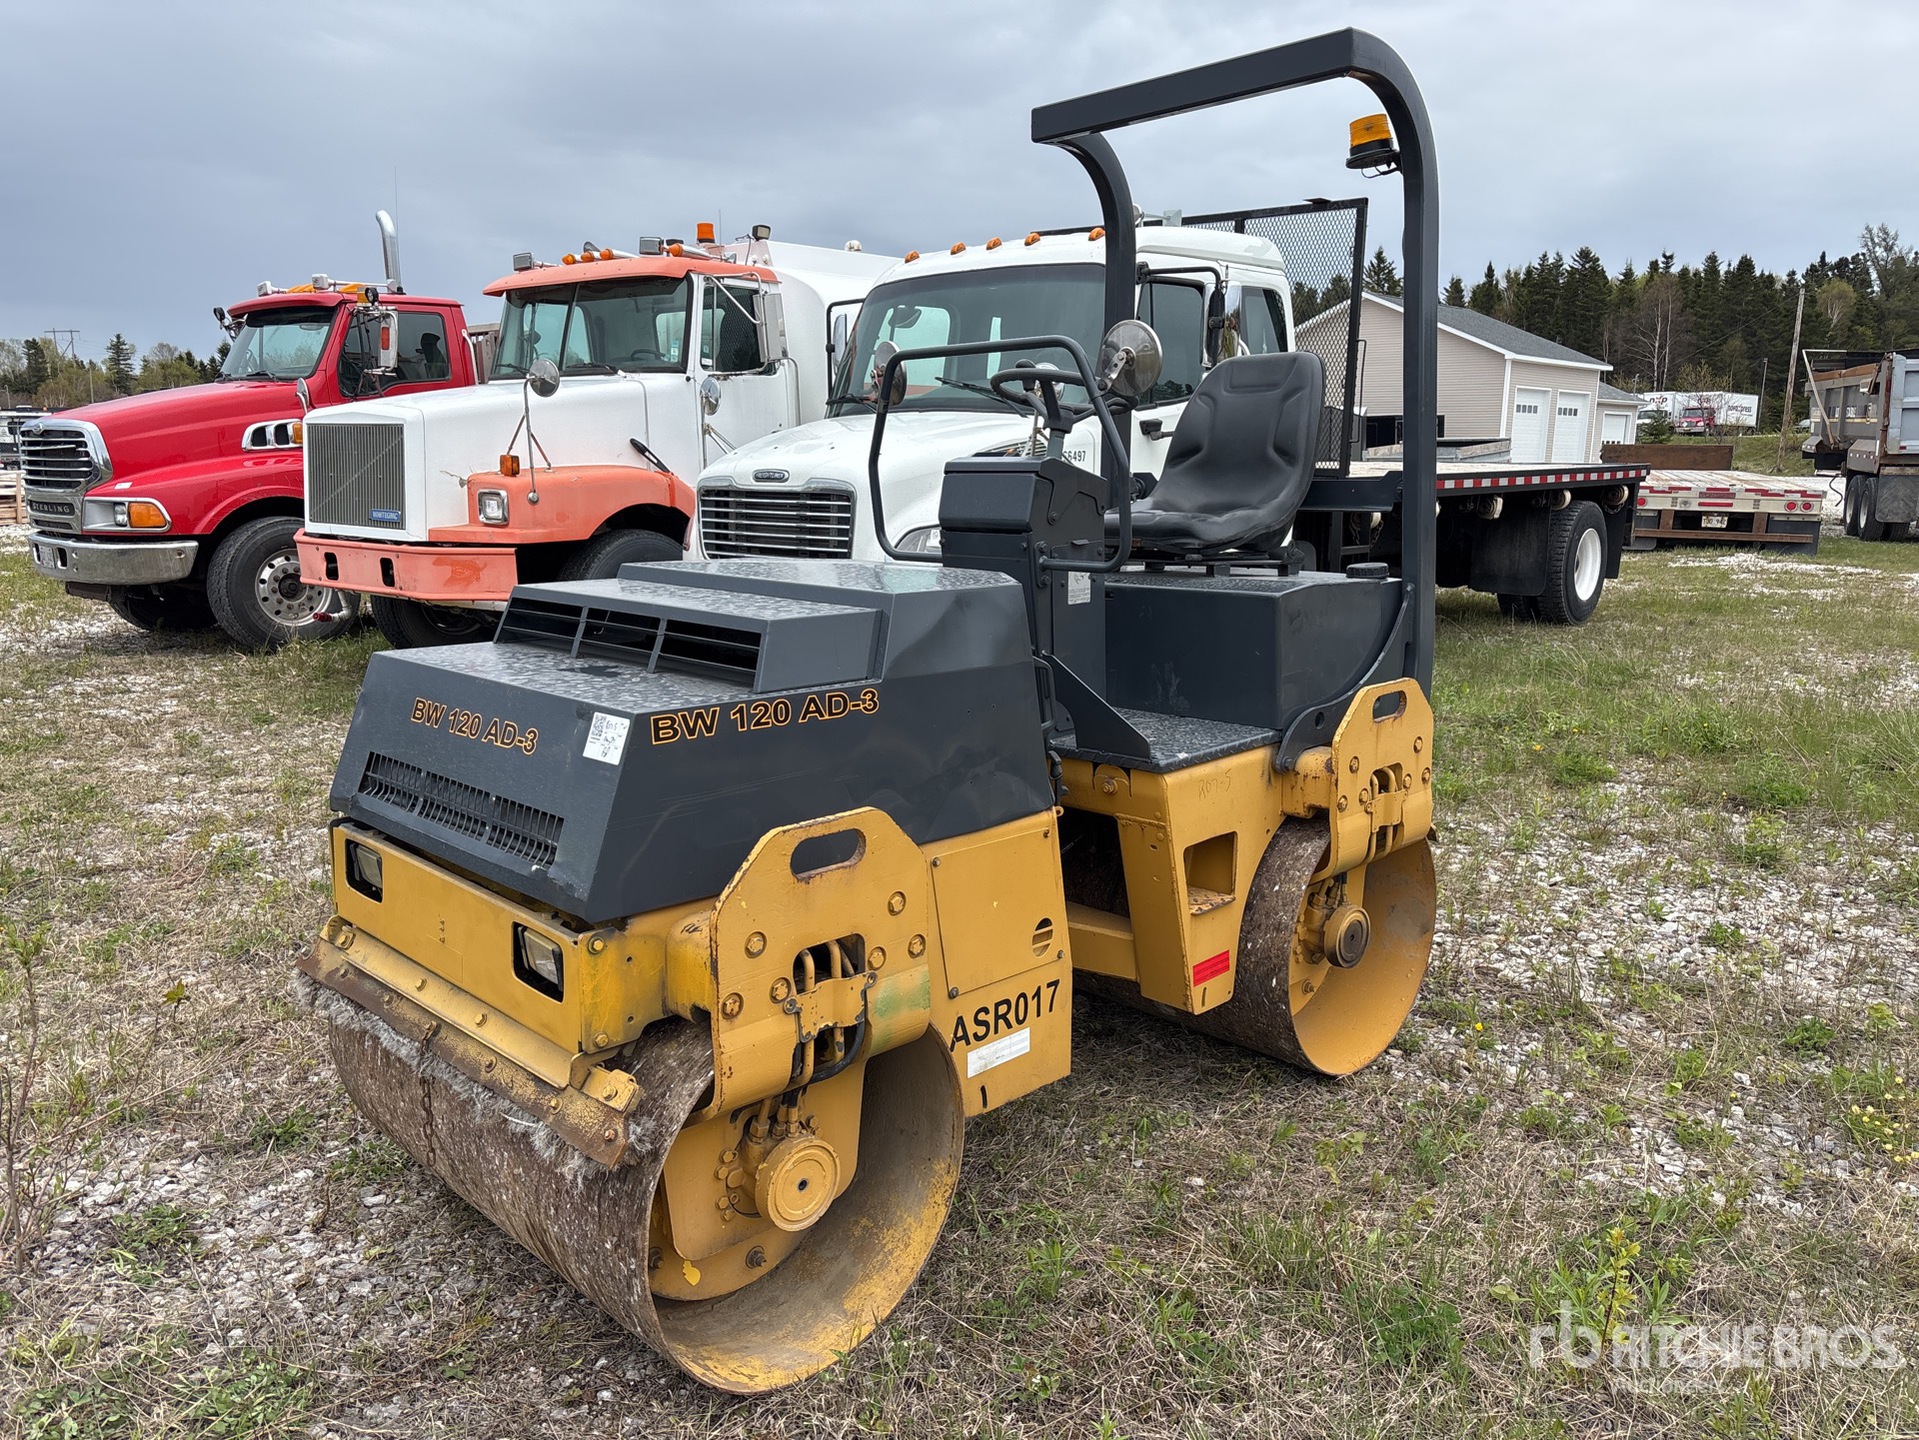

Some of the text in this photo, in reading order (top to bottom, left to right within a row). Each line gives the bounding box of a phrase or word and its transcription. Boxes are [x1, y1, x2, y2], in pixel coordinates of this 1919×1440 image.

[32, 503, 70, 513] STERLING
[410, 697, 539, 755] BW 120 AD-3
[650, 706, 720, 745] BW
[730, 698, 792, 732] 120
[798, 687, 879, 723] AD-3
[949, 978, 1060, 1053] ASR017
